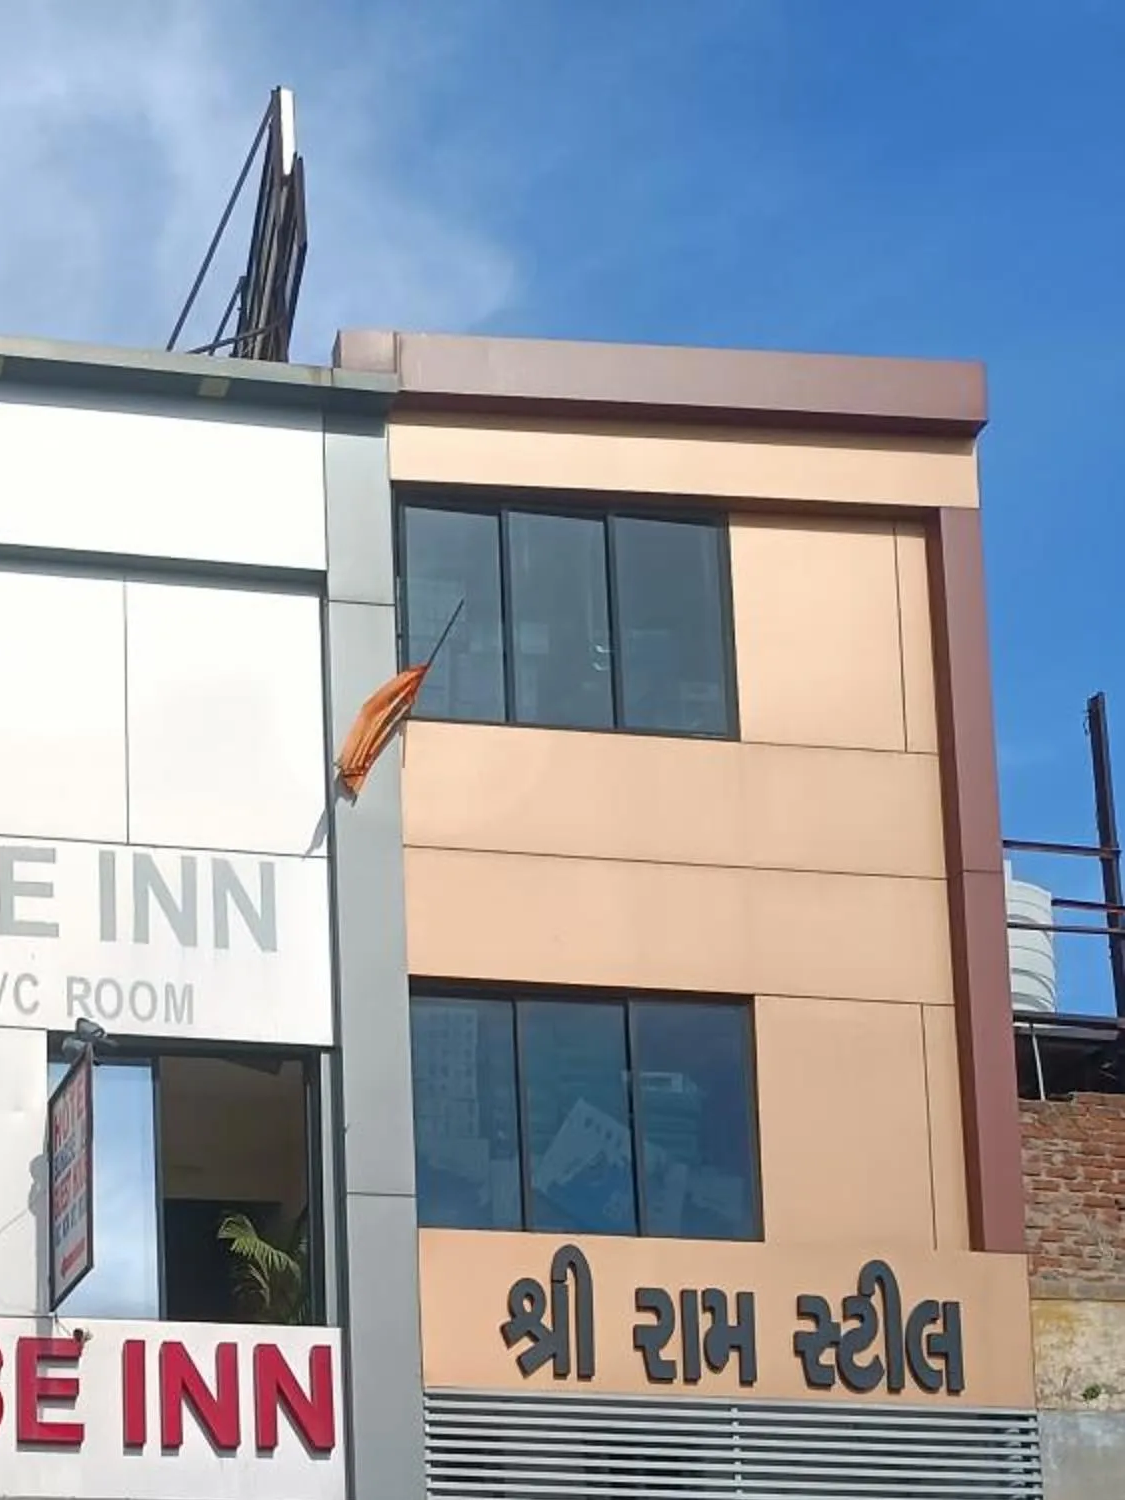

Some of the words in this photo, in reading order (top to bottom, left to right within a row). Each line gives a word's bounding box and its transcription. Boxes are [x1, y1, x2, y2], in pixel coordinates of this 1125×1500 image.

[98, 849, 278, 953] INN
[65, 976, 195, 1025] ROOM
[499, 1243, 595, 1379] શ્રી
[633, 1286, 757, 1386] રામ
[793, 1258, 965, 1395] સ્ટીલ
[122, 1339, 336, 1451] INN
